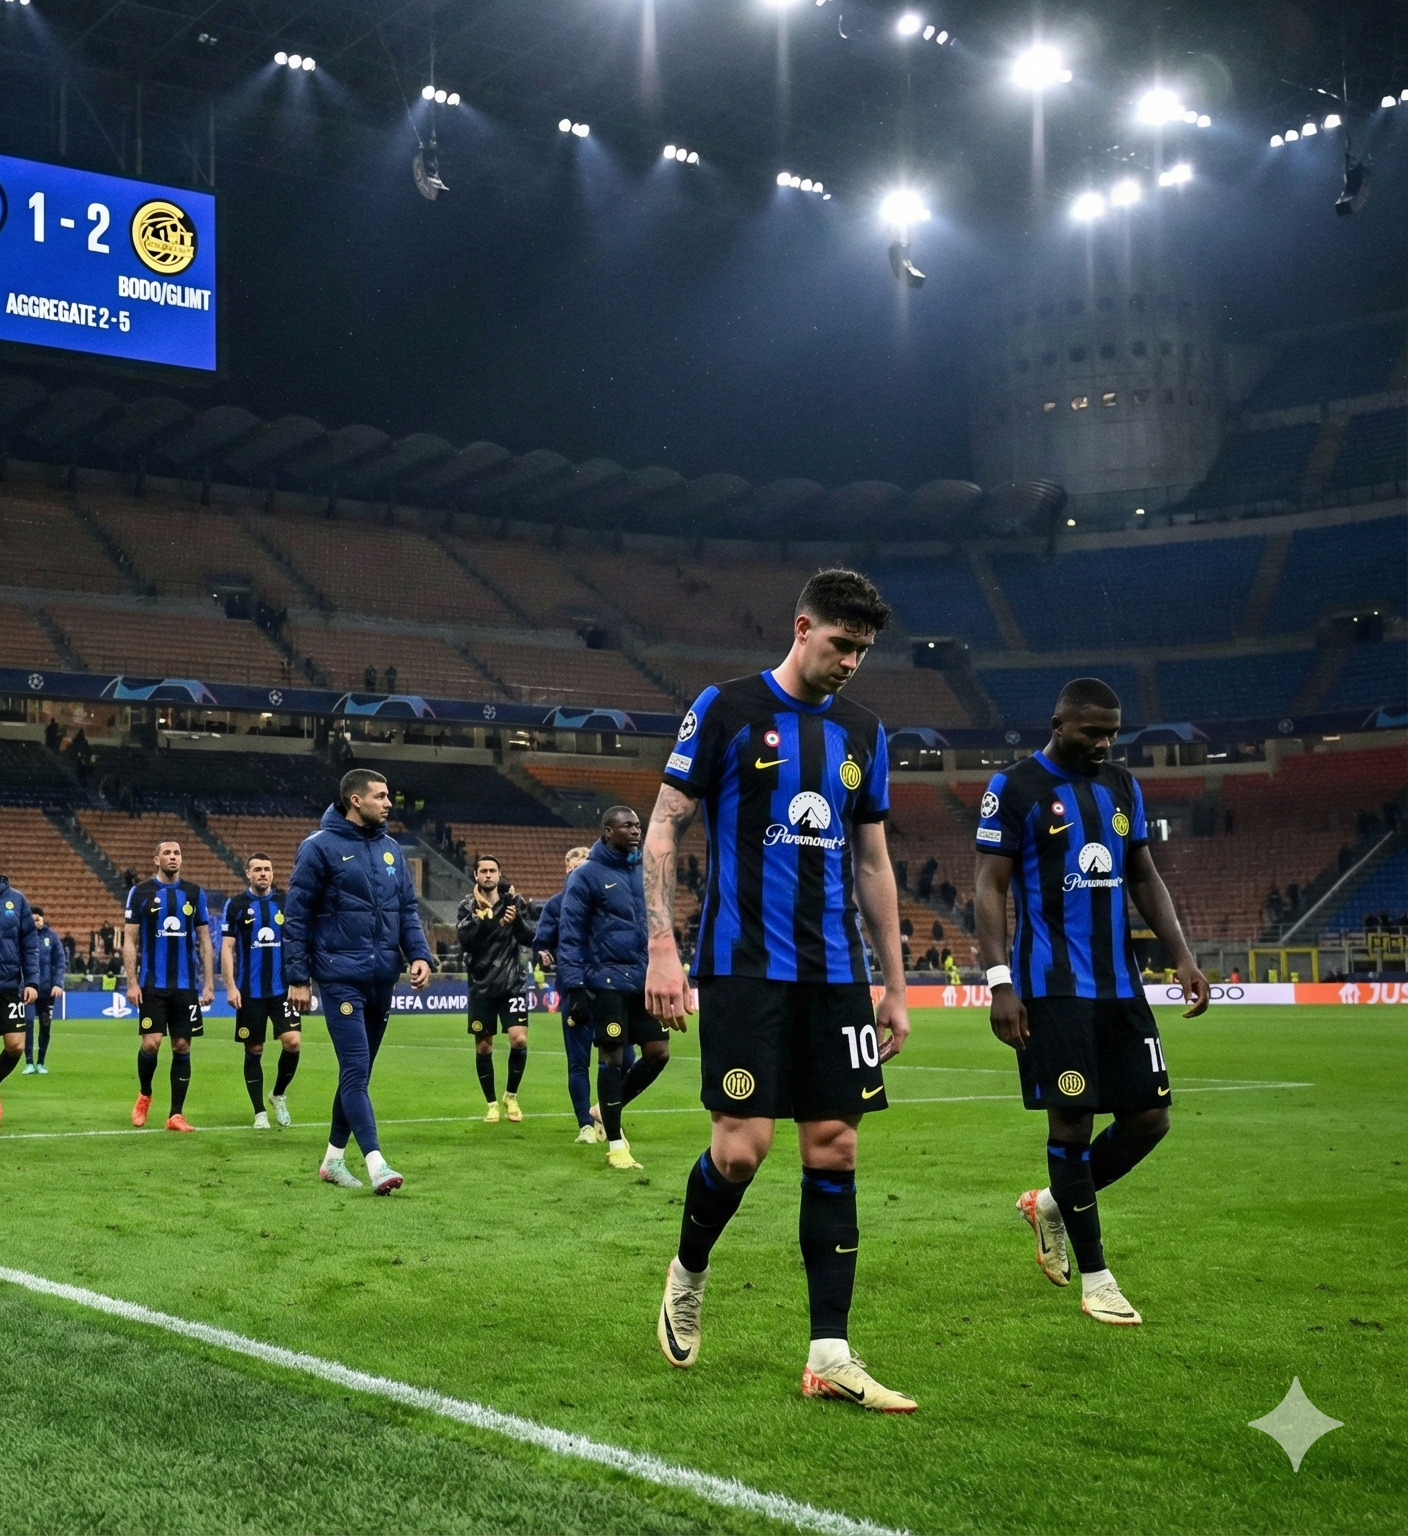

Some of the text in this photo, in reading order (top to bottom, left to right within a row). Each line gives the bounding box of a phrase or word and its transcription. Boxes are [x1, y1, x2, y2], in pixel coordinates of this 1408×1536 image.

[29, 192, 44, 242] 1
[88, 203, 110, 254] 2
[6, 292, 97, 327] AGGREGATE
[119, 275, 211, 311] BODO/GLIMT
[8, 1002, 25, 1019] 20
[842, 1024, 879, 1069] 10
